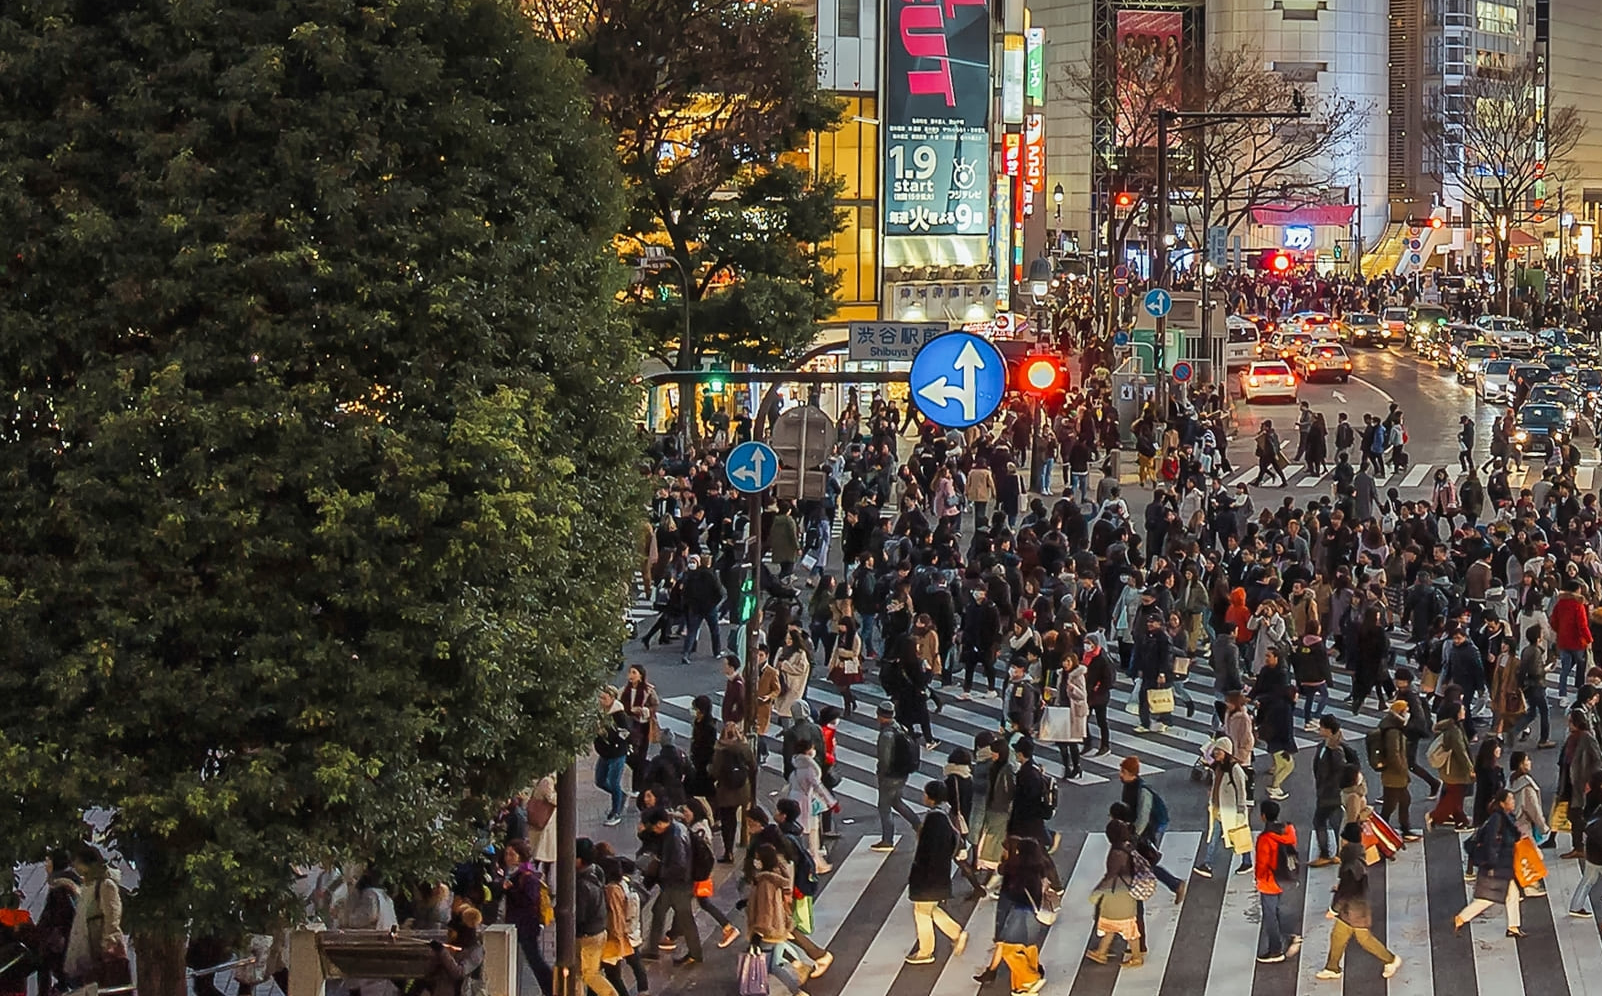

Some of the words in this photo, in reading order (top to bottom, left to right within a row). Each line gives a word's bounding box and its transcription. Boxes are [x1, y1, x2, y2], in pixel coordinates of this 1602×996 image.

[1030, 59, 1041, 87] レイク
[889, 145, 937, 179] 1.9
[1028, 146, 1040, 176] アコム
[894, 180, 934, 192] start
[947, 190, 982, 200] フジテレビ
[870, 346, 908, 358] Shibuya
